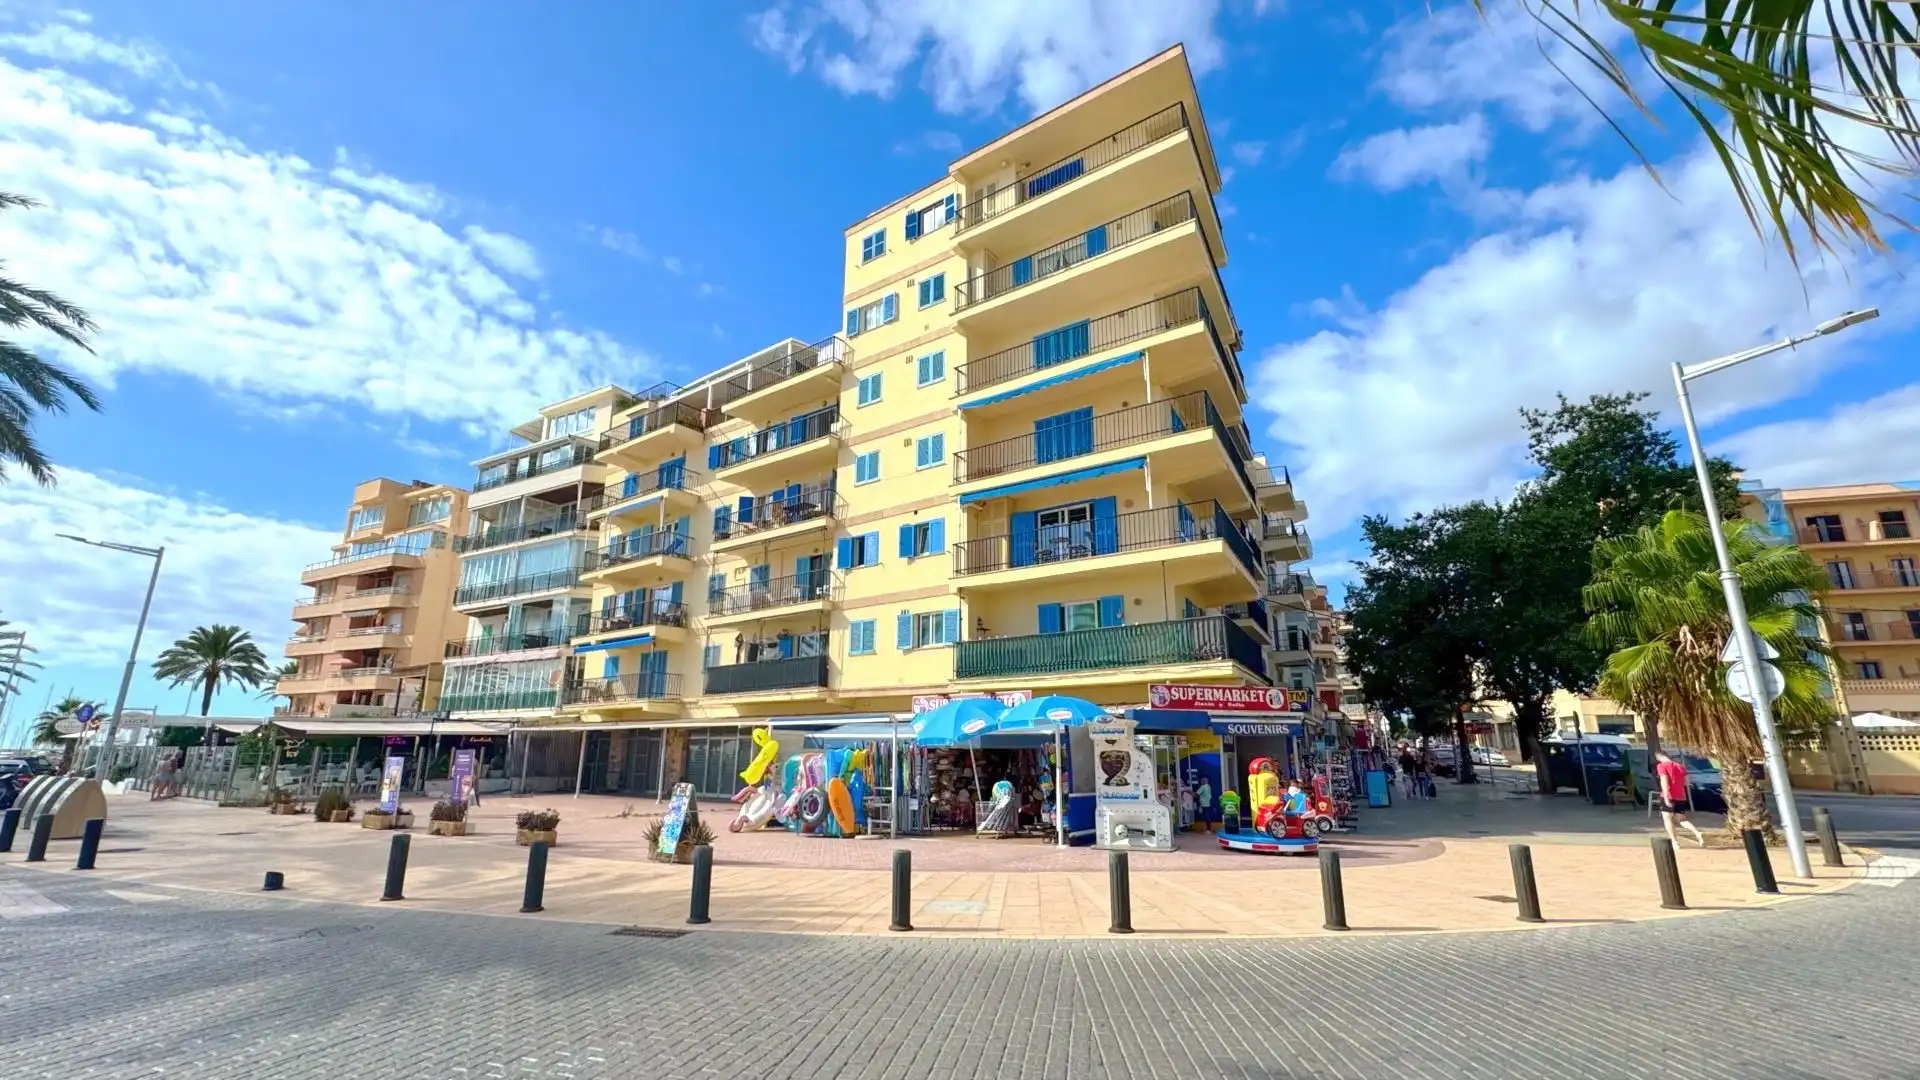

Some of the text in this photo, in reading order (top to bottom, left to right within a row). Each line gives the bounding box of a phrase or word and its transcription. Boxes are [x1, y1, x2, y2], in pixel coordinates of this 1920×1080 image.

[1170, 687, 1265, 703] SUPERMARKET
[1288, 691, 1306, 701] TM
[1227, 724, 1290, 735] SOUVENIRS
